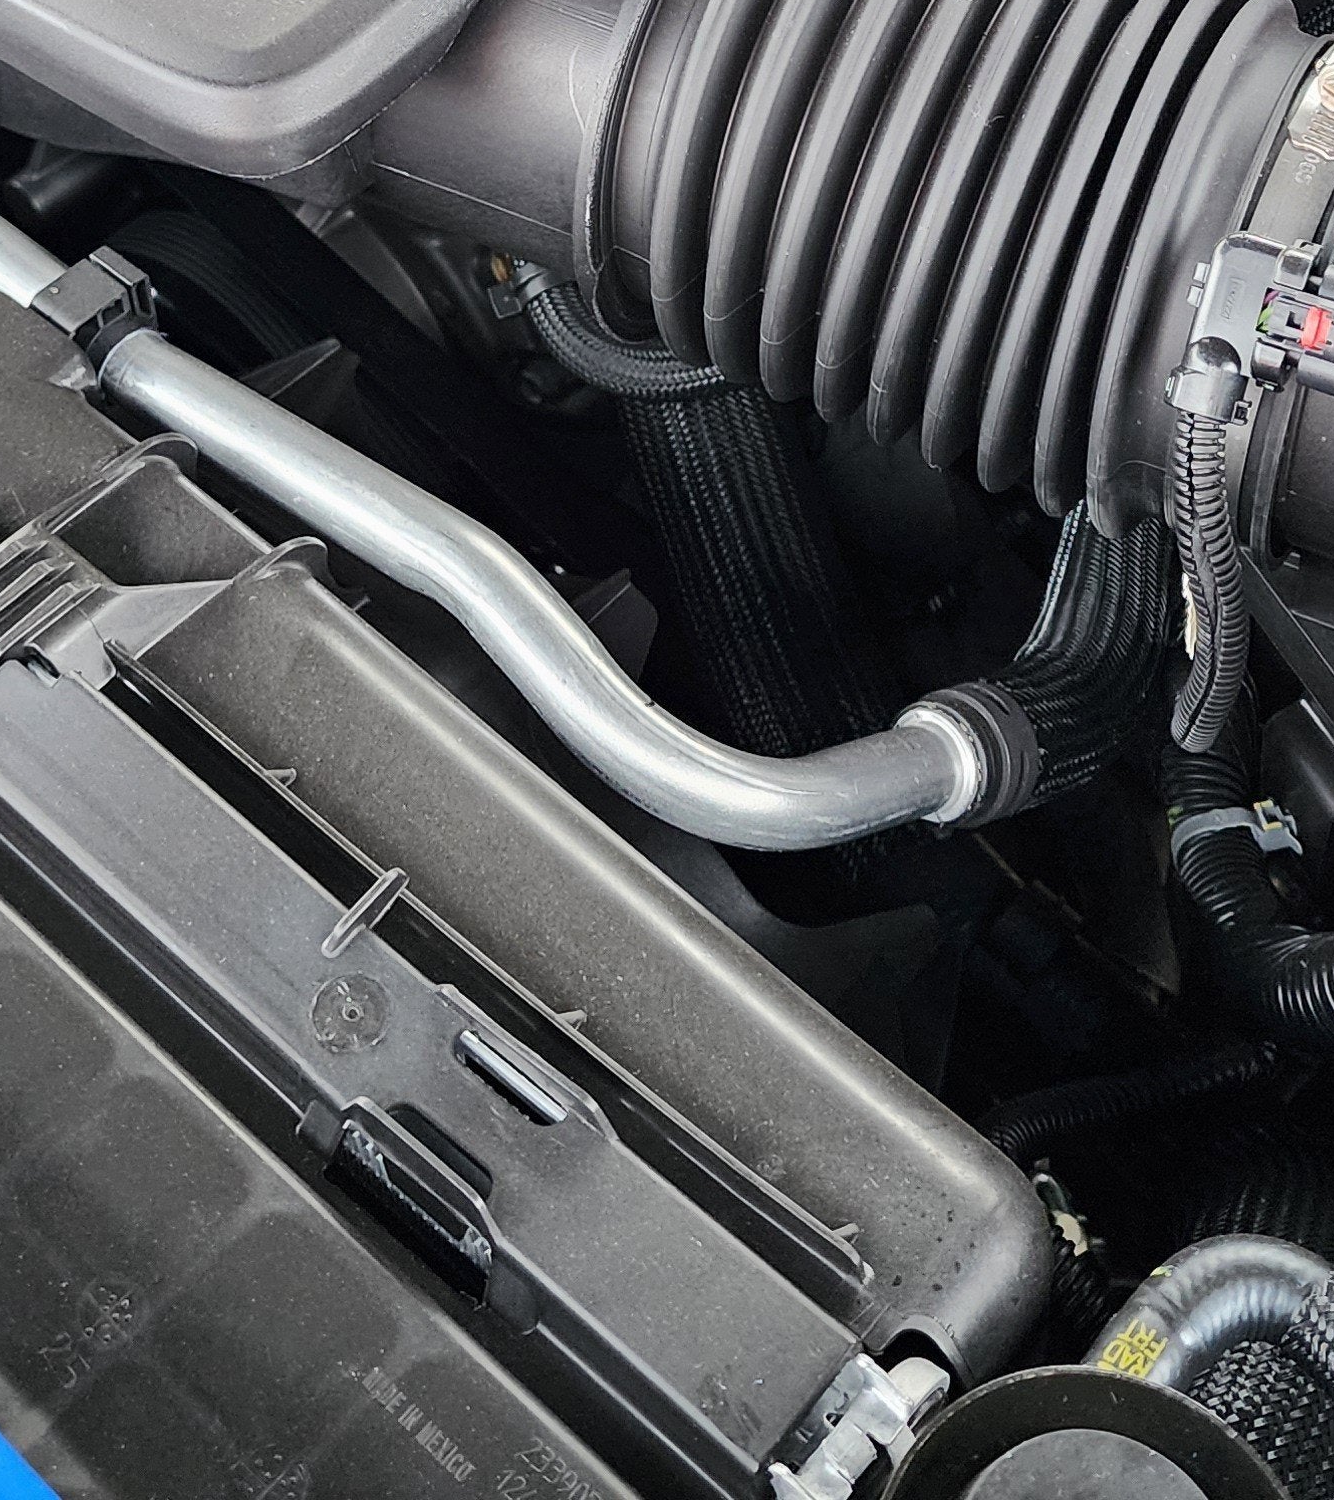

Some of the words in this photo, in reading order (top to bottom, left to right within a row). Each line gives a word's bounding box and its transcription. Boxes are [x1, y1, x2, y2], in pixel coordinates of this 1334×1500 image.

[1102, 1339, 1155, 1378] RAD
[1116, 1318, 1169, 1361] FRT
[397, 1403, 424, 1432] IN
[415, 1420, 477, 1482] MEXICO
